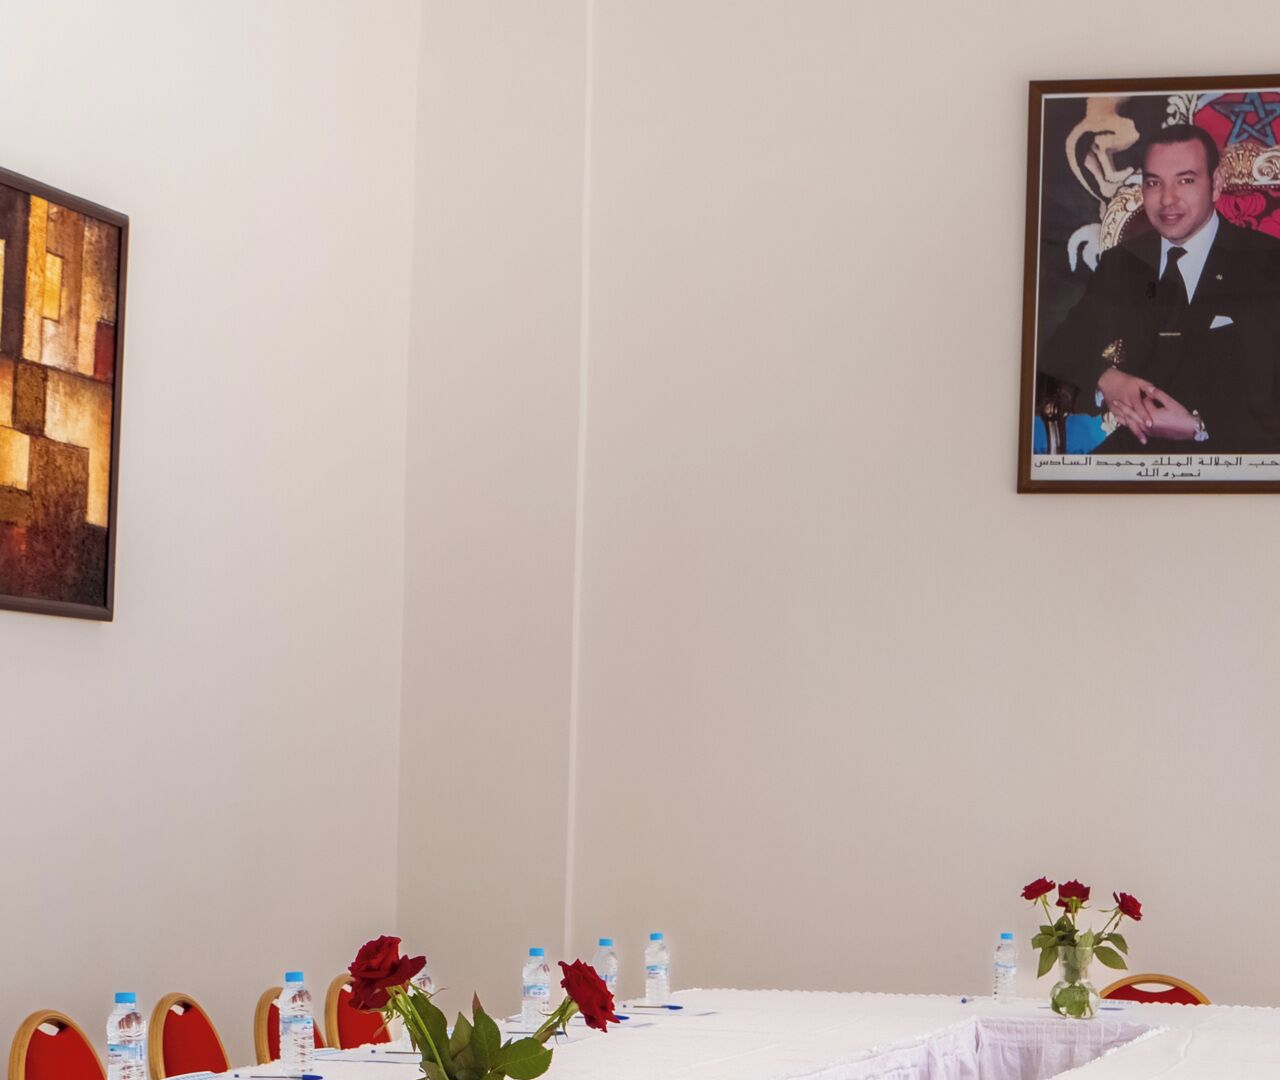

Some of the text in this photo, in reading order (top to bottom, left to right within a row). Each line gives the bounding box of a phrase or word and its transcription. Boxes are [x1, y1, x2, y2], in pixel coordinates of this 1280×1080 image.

[1034, 456, 1091, 468] السادس
[1096, 459, 1146, 467] محمد
[1151, 456, 1192, 467] الملك
[1198, 456, 1242, 468] الجلالة
[1136, 467, 1201, 479] نصره الله
